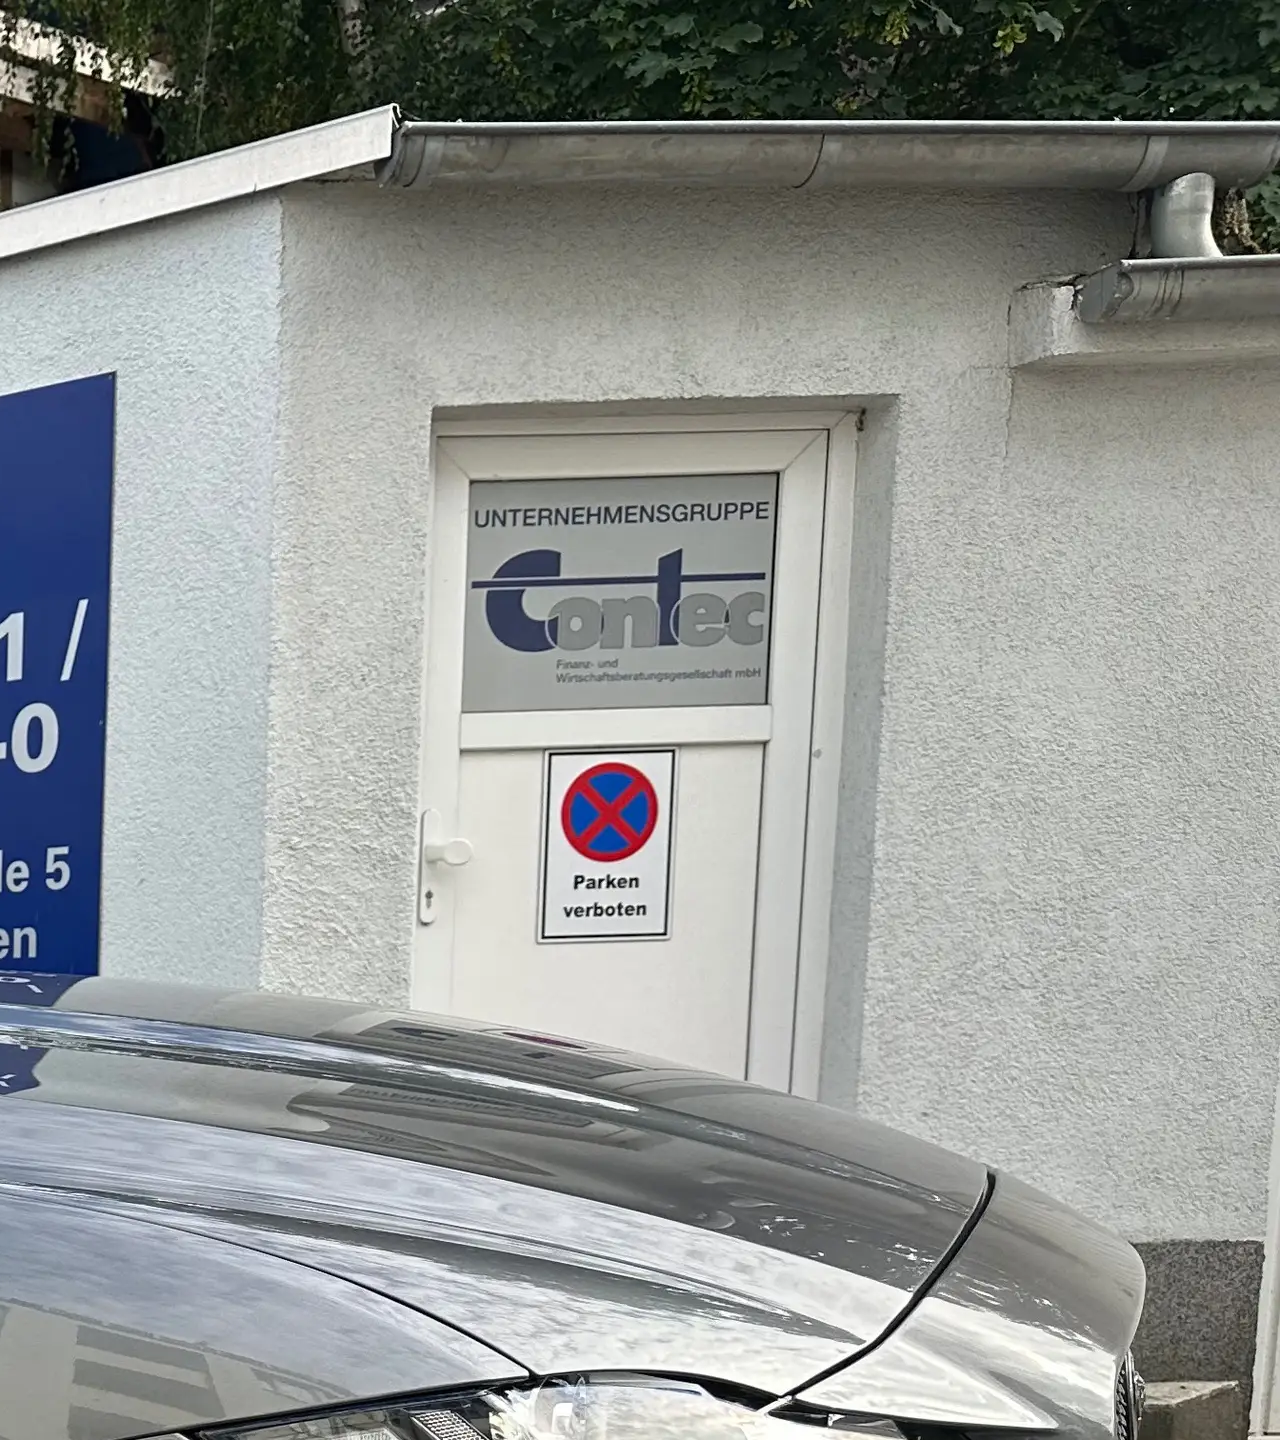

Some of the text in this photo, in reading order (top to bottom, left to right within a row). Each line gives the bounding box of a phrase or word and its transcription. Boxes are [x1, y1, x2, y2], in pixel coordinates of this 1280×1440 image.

[474, 501, 770, 528] UNTERNEHMENSGRUPPE
[480, 548, 766, 652] Contec
[60, 598, 89, 682] /
[597, 658, 619, 668] und
[735, 667, 762, 678] mbH
[44, 845, 72, 892] 5
[573, 874, 640, 890] Parken
[562, 900, 648, 918] verboten
